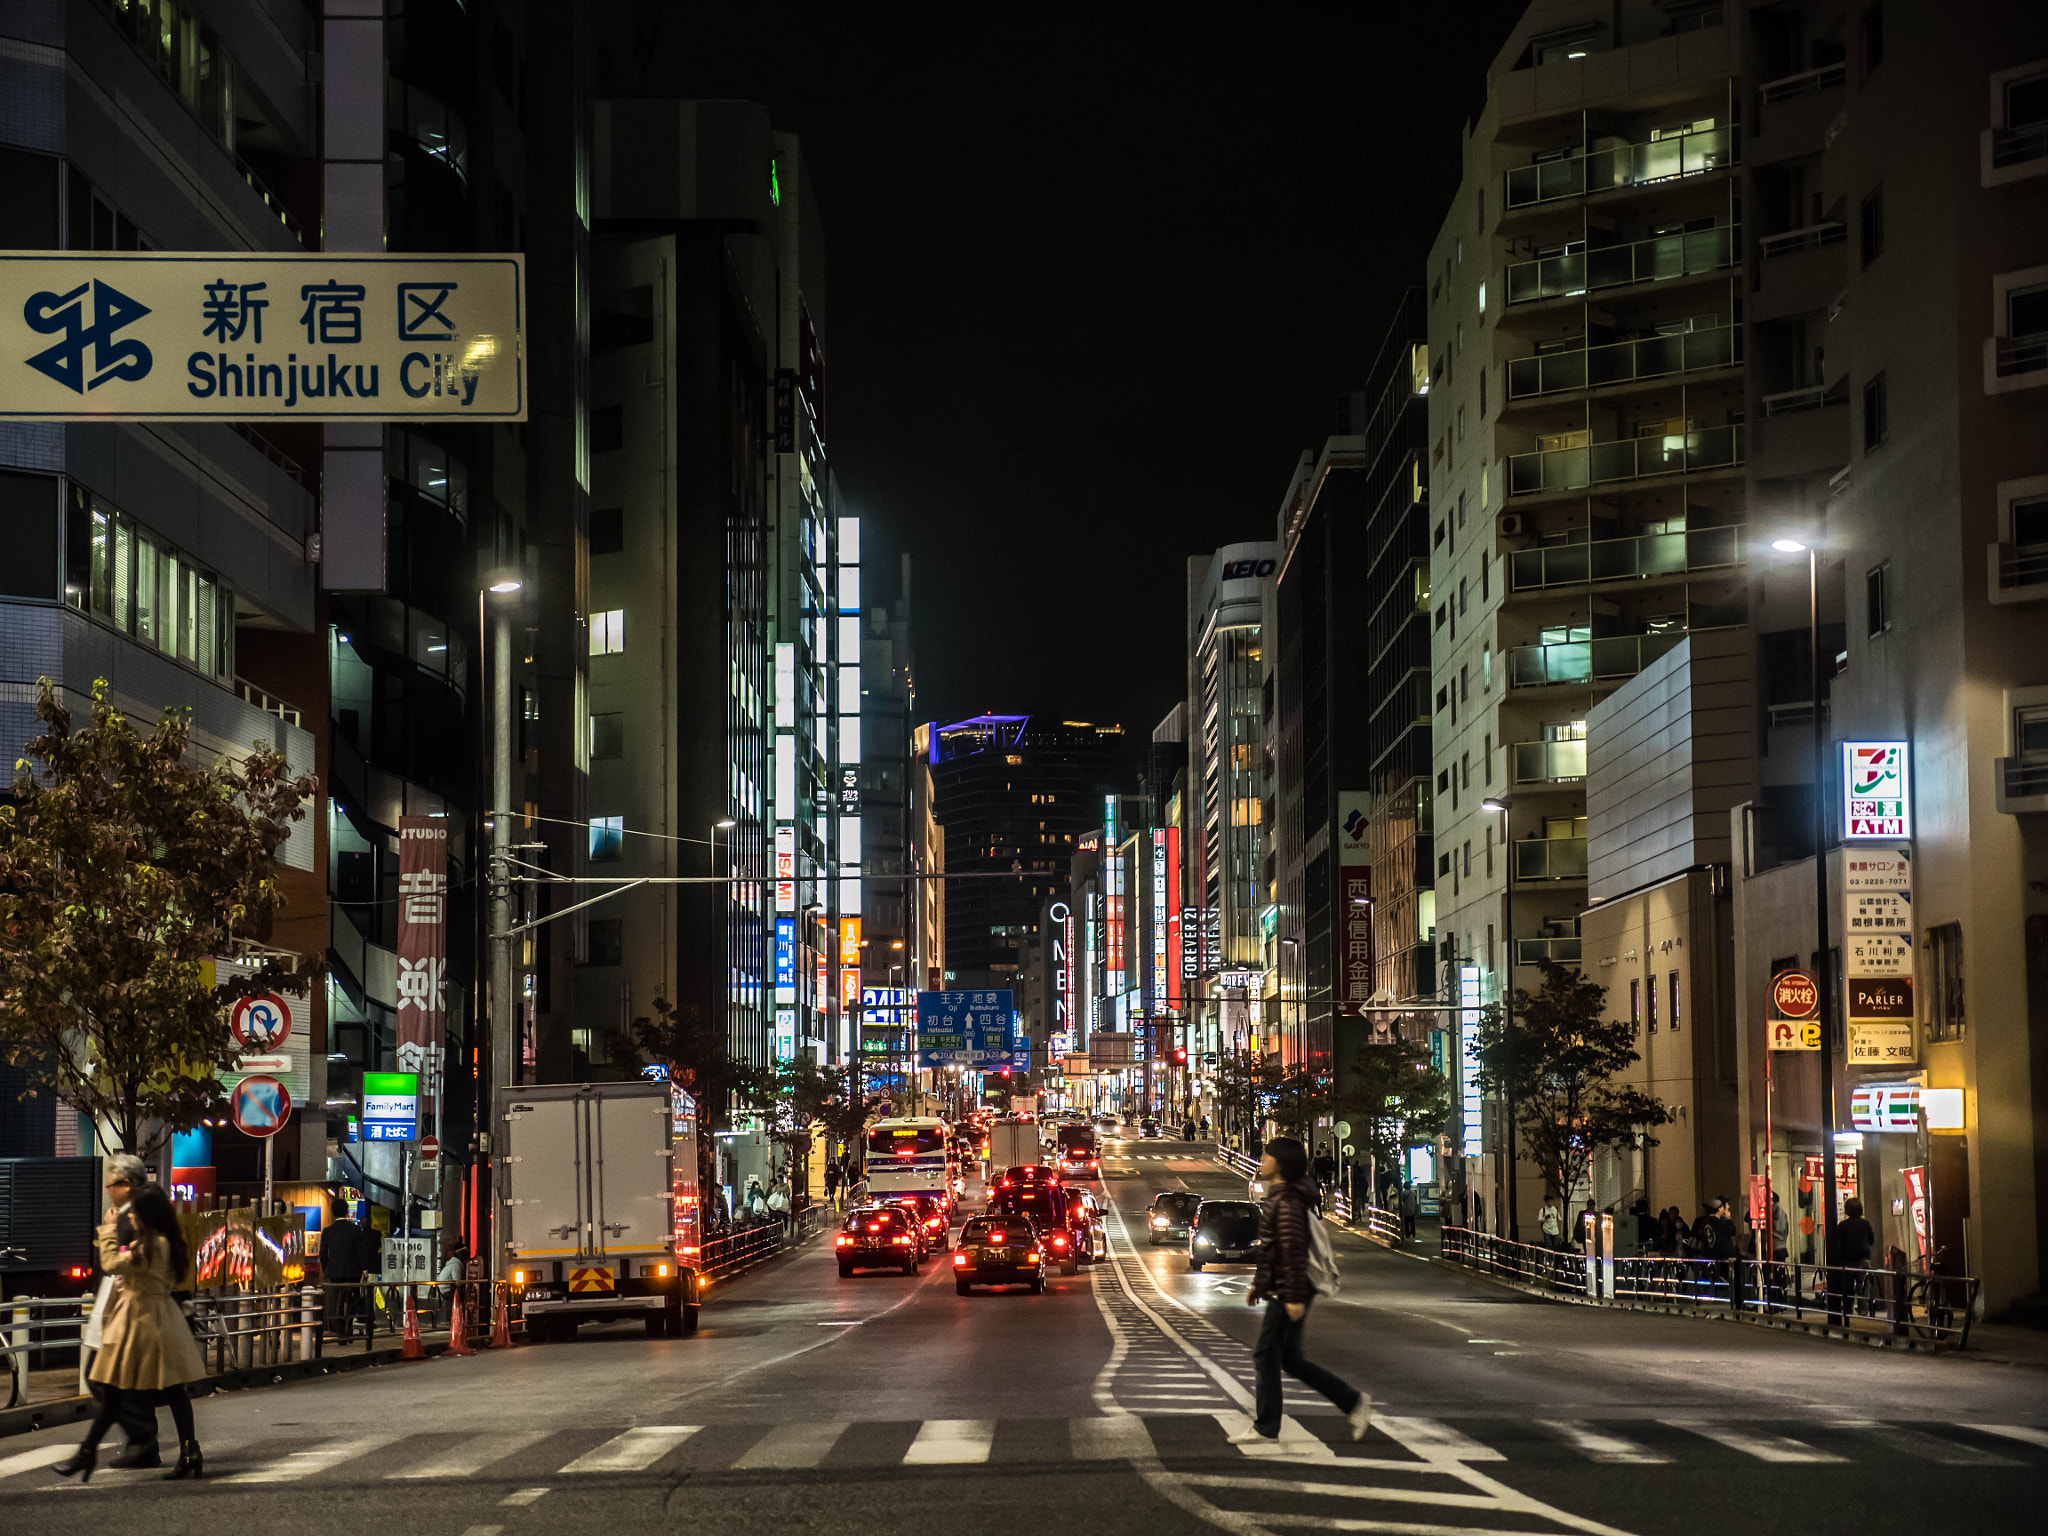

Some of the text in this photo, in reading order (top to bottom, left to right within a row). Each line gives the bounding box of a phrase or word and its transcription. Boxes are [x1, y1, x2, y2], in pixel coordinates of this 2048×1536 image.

[203, 278, 459, 345] 新宿区
[187, 351, 480, 406] Shinjuku City
[1222, 559, 1276, 581] KEIO
[1882, 801, 1897, 816] 酒
[401, 828, 447, 840] STUDIO
[1855, 820, 1900, 834] ATM
[778, 853, 791, 900] ISAMI
[1852, 917, 1906, 927] 関根事務所
[1184, 907, 1198, 979] FOREVER 21
[1347, 879, 1369, 1001] 西京信用金庫
[1855, 947, 1906, 956] 石川利男
[940, 993, 997, 1004] 王子 池袋
[1779, 987, 1813, 1004] 消火栓
[1859, 992, 1904, 1005] PARLER
[863, 989, 905, 1023] 24H
[927, 1015, 953, 1026] 初台
[980, 1014, 1006, 1025] 四谷
[1802, 1024, 1820, 1045] P
[1854, 1046, 1911, 1057] 佐藤 文昭
[365, 1102, 414, 1112] FamilyMart
[371, 1126, 408, 1138] 酒 たばこ
